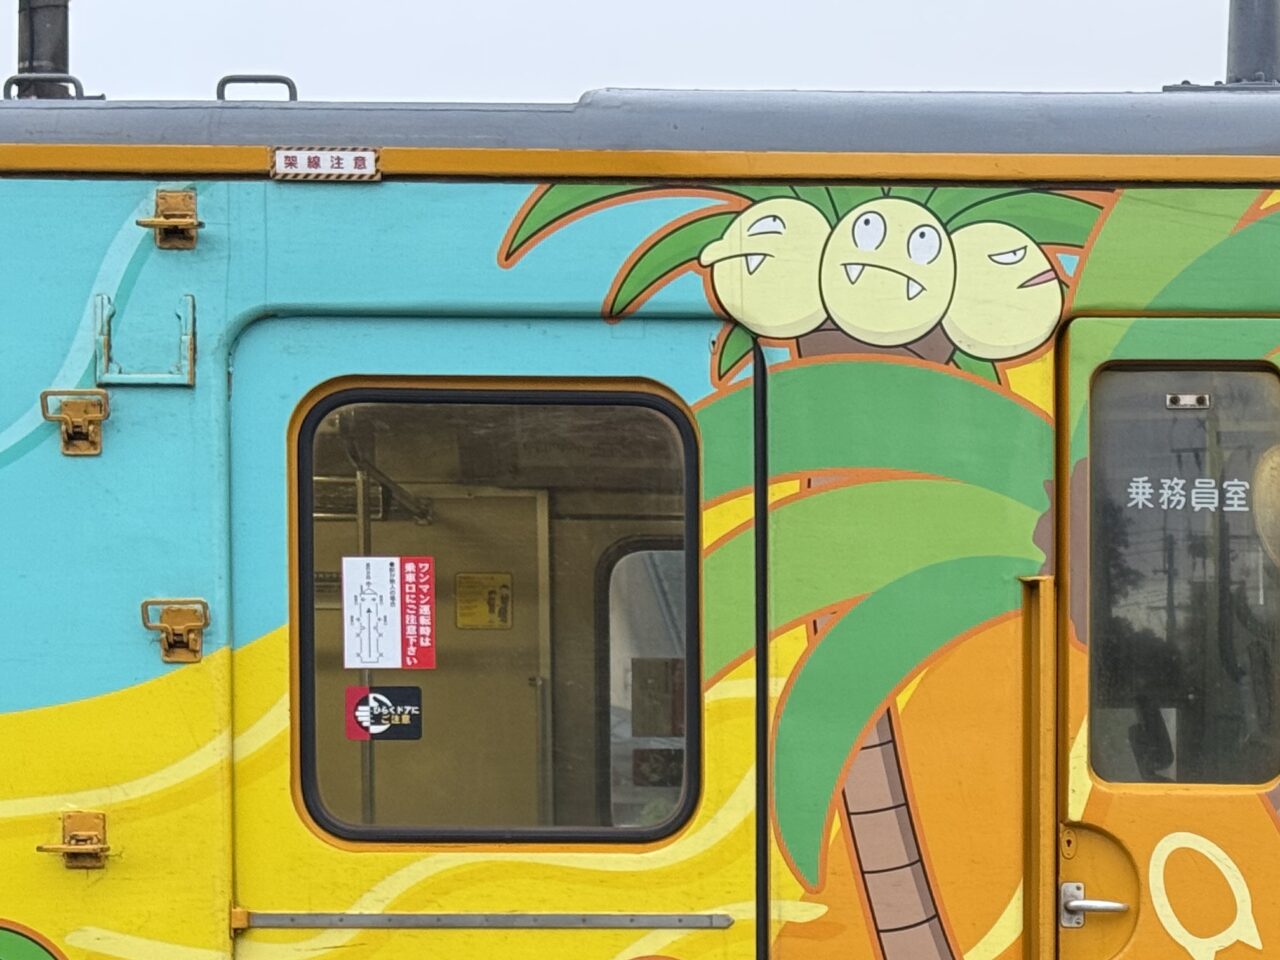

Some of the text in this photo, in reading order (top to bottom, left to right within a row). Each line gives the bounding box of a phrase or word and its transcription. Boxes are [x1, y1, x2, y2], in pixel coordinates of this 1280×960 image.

[284, 155, 367, 170] 架線注意
[1127, 476, 1250, 512] 乗務員室
[404, 562, 418, 666] 乗車口にご注意下さい
[418, 562, 432, 647] ワンマン運転時は
